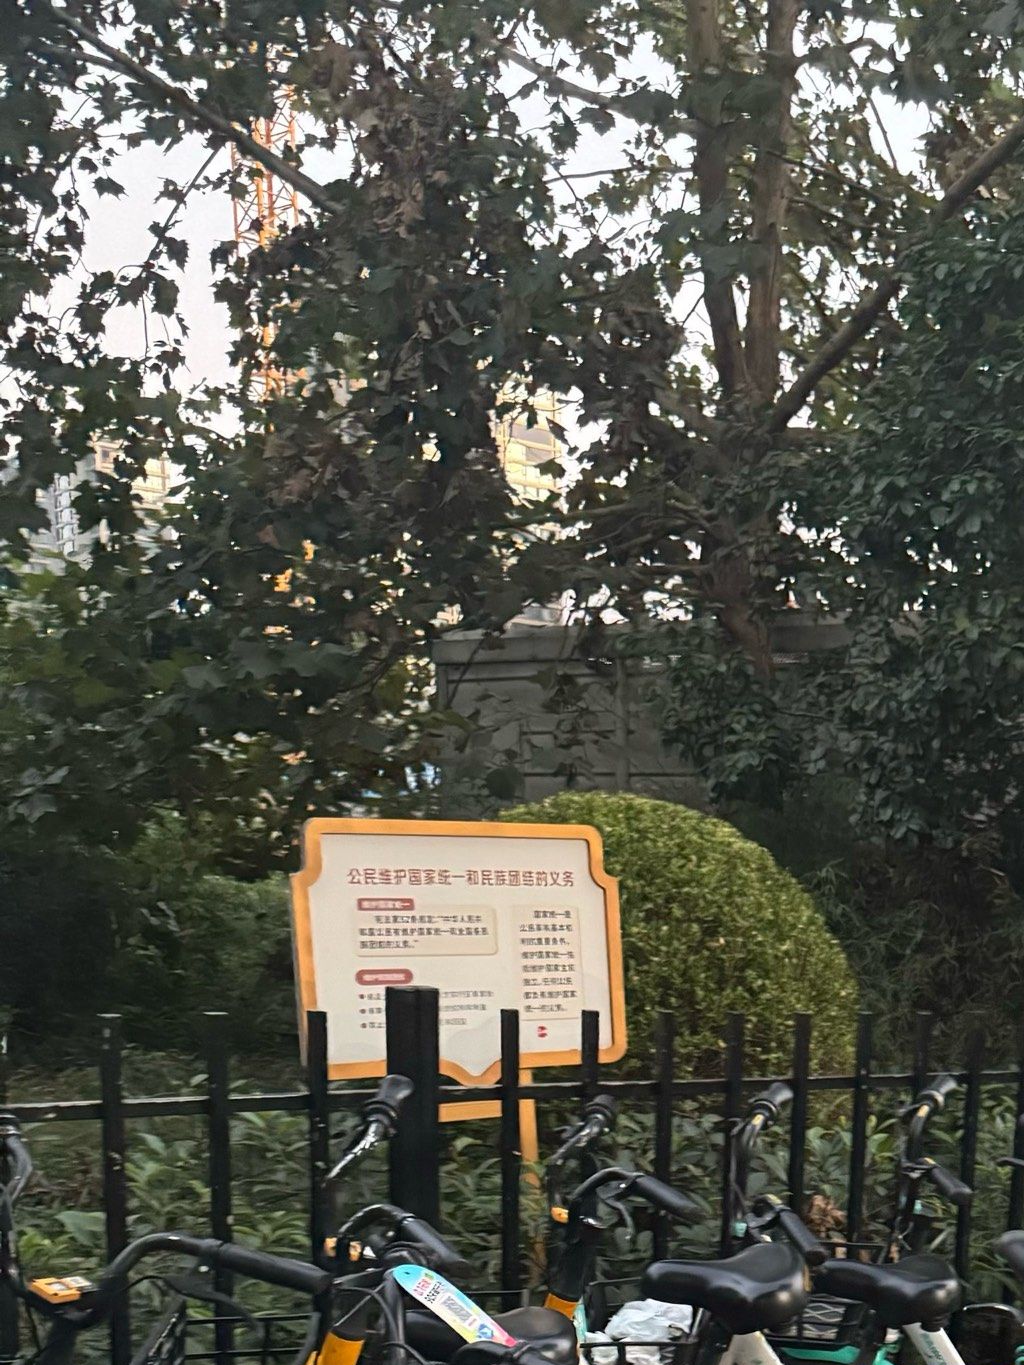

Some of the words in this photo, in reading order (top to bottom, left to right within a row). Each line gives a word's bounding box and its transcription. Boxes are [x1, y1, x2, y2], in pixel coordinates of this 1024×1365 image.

[347, 868, 575, 887] 公民维护国家统一和民族团结的义务
